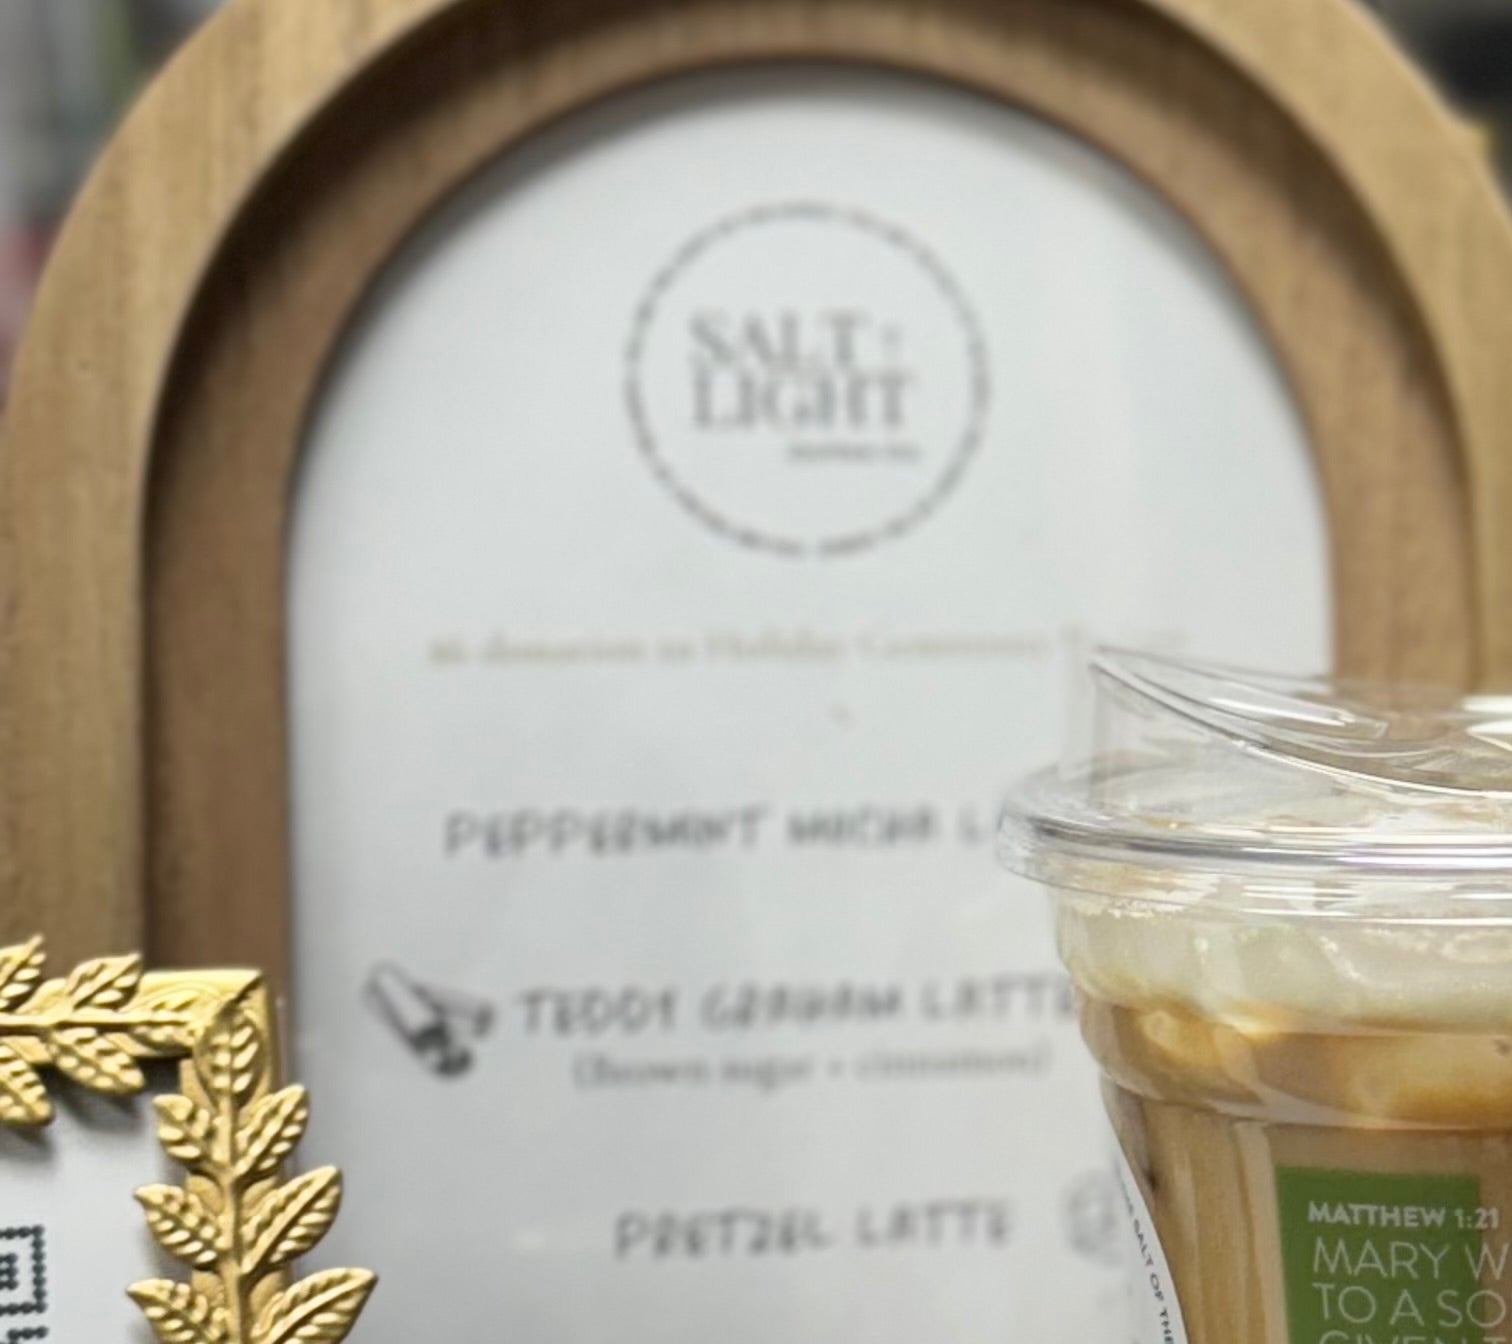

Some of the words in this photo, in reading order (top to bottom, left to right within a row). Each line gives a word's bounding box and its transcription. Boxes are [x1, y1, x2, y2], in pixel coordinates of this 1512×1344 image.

[688, 306, 872, 368] SALT
[690, 360, 915, 430] LIGHT
[516, 986, 679, 1037] TEDDY
[613, 1203, 838, 1262] PRETZEL
[853, 1196, 1021, 1252] LATTE
[1307, 1200, 1447, 1229] MATTHEW
[1453, 1207, 1500, 1230] 1:21
[1312, 1235, 1451, 1280] MARY
[1311, 1281, 1377, 1324] TO
[1389, 1288, 1426, 1327] A
